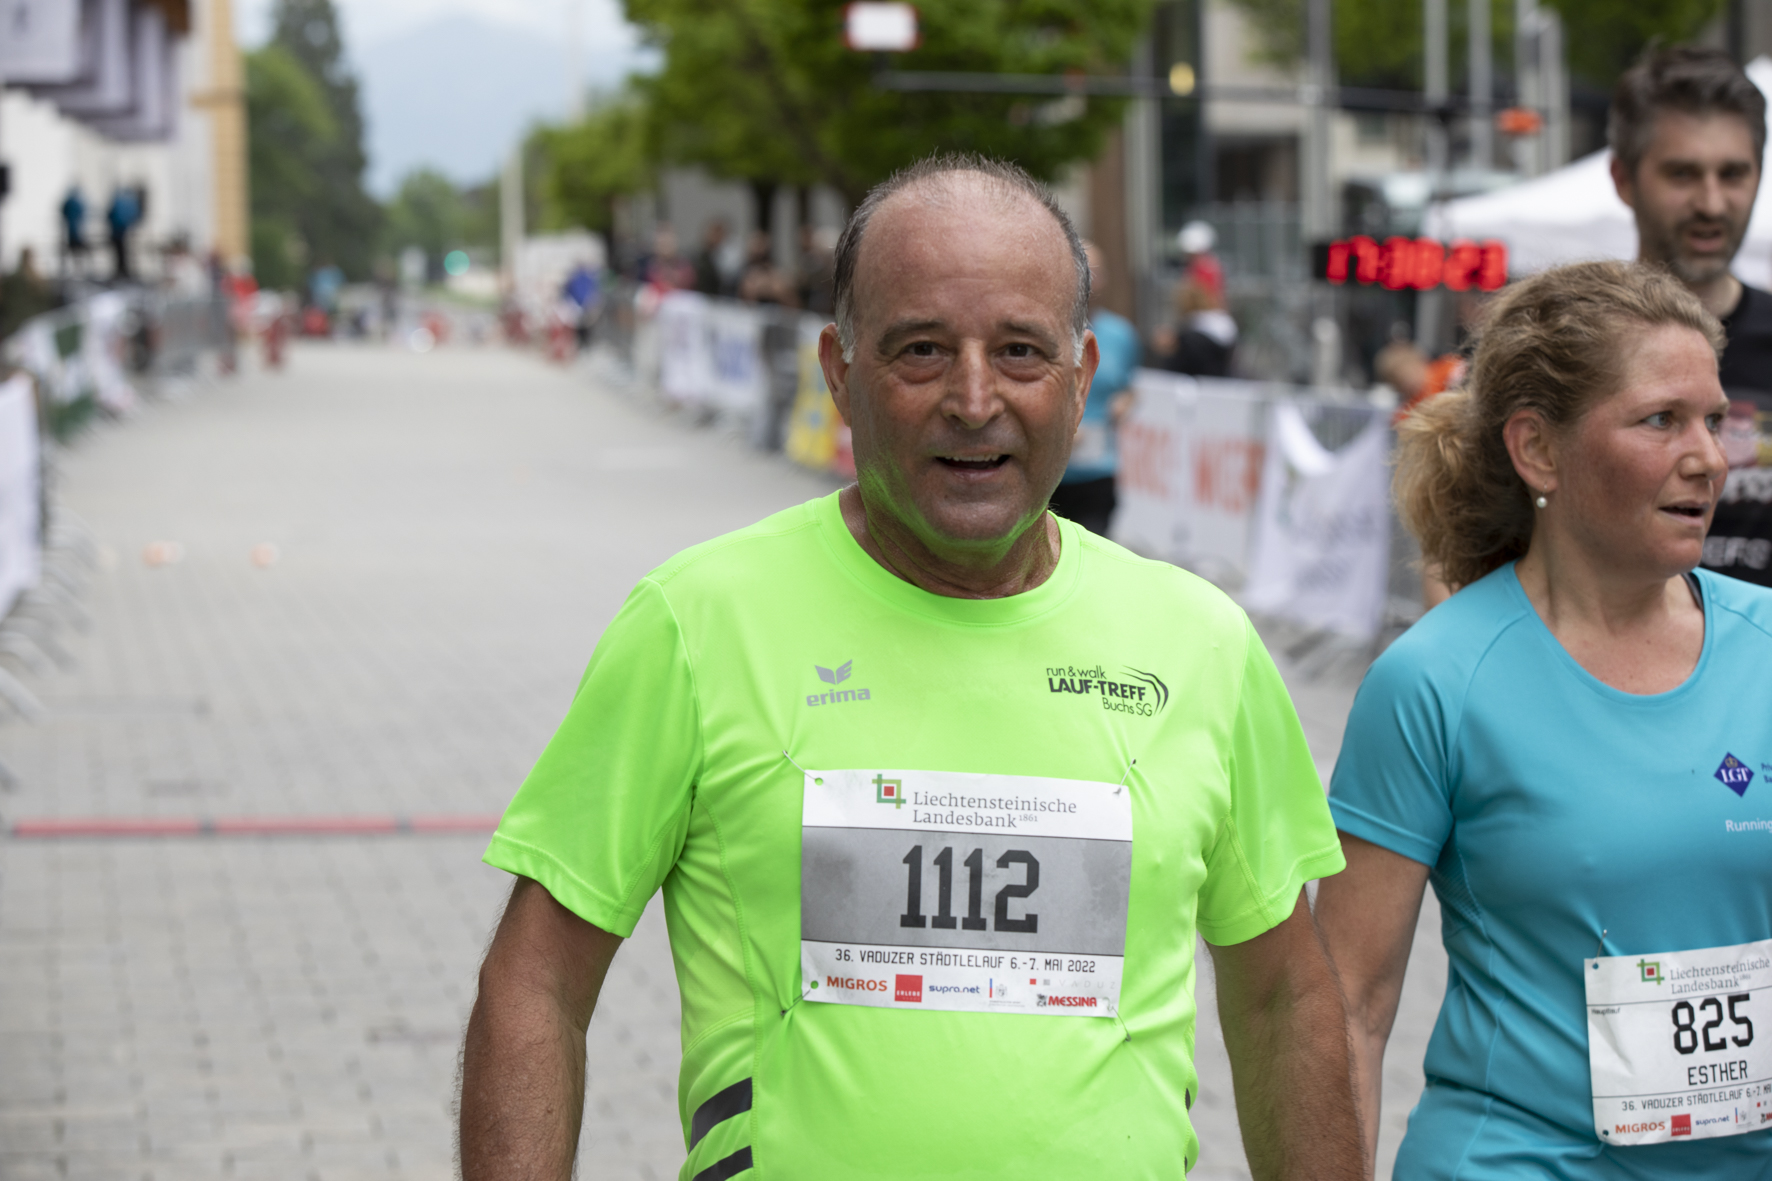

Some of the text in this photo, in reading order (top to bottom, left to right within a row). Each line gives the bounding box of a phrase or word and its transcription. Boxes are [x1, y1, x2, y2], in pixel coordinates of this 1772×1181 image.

[806, 687, 871, 707] erima
[1048, 677, 1146, 701] LAUF-TREFF
[1102, 697, 1153, 717] Buchs SG
[1721, 767, 1749, 783] LGT
[913, 791, 1077, 814] Liechtensteinische
[912, 809, 1038, 828] Landesbank 1861
[900, 845, 1040, 934] 1112
[835, 948, 854, 962] 36.
[860, 950, 915, 965] VADUZER
[920, 951, 1005, 969] STÄDTLELAUF
[1044, 958, 1063, 972] MAI
[1067, 959, 1096, 973] 2022
[1670, 957, 1770, 980] Liechtensteinische
[826, 975, 888, 992] MIGROS
[929, 985, 980, 994] supra.net
[1671, 975, 1740, 995] Landesbank
[1048, 995, 1098, 1007] MESSINA
[1671, 992, 1754, 1055] 825
[1688, 1060, 1748, 1086] ESTHER
[1622, 1101, 1637, 1111] 36.
[1641, 1096, 1684, 1110] VADUZER
[1615, 1121, 1666, 1134] MIGROS
